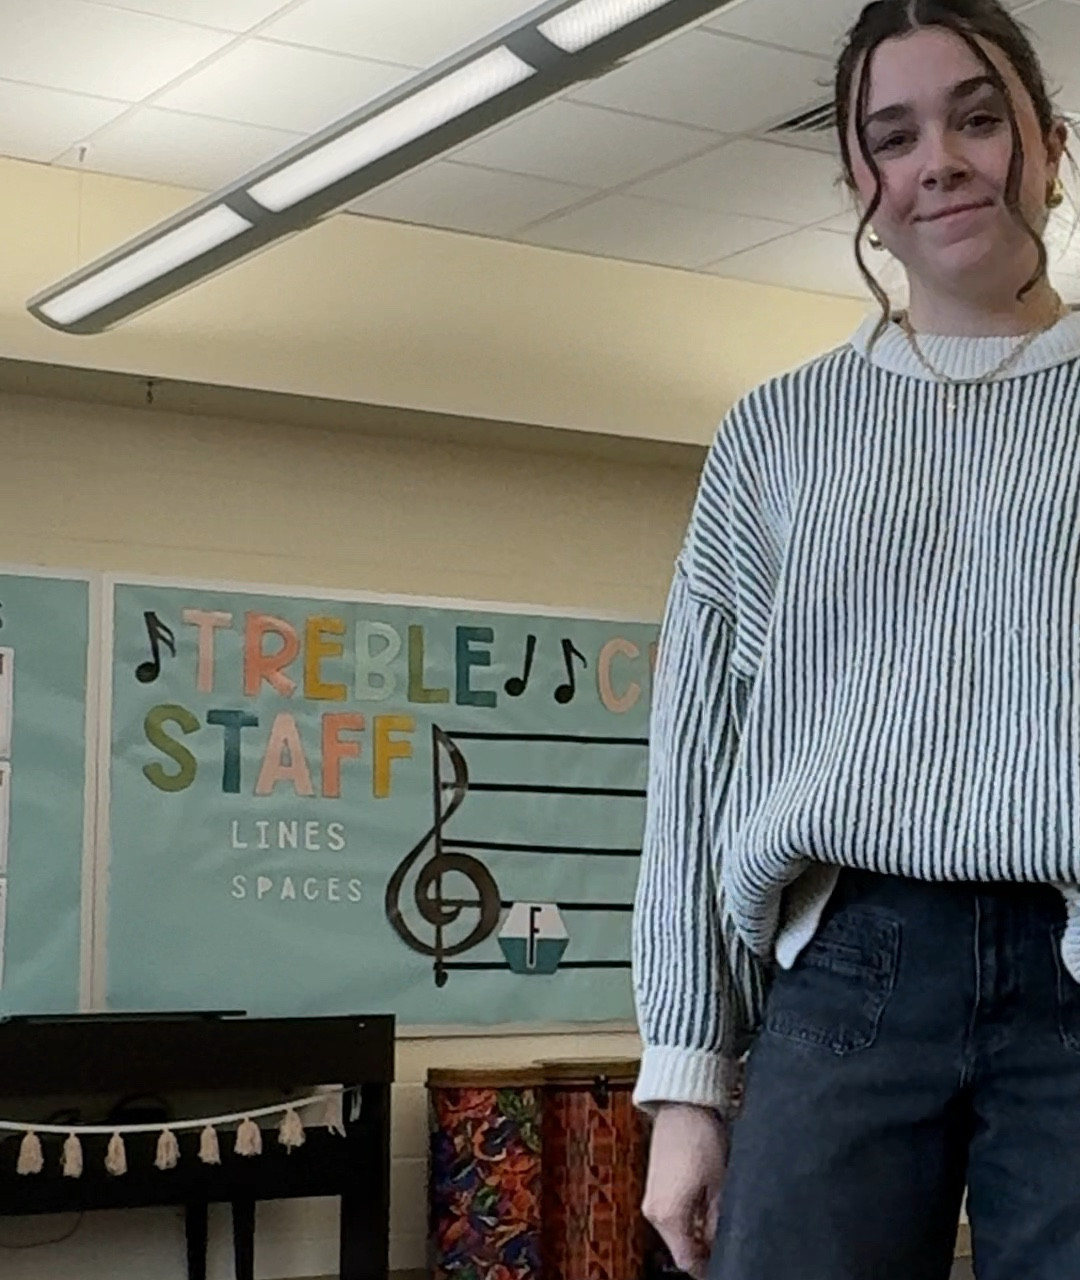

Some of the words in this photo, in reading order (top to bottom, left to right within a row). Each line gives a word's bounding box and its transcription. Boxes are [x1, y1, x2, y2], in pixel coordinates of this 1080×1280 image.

[182, 608, 498, 708] TREBLE
[596, 635, 657, 715] C
[142, 703, 417, 799] STAFF
[232, 820, 346, 851] LINES
[231, 874, 362, 902] SPACES
[529, 905, 543, 966] F
